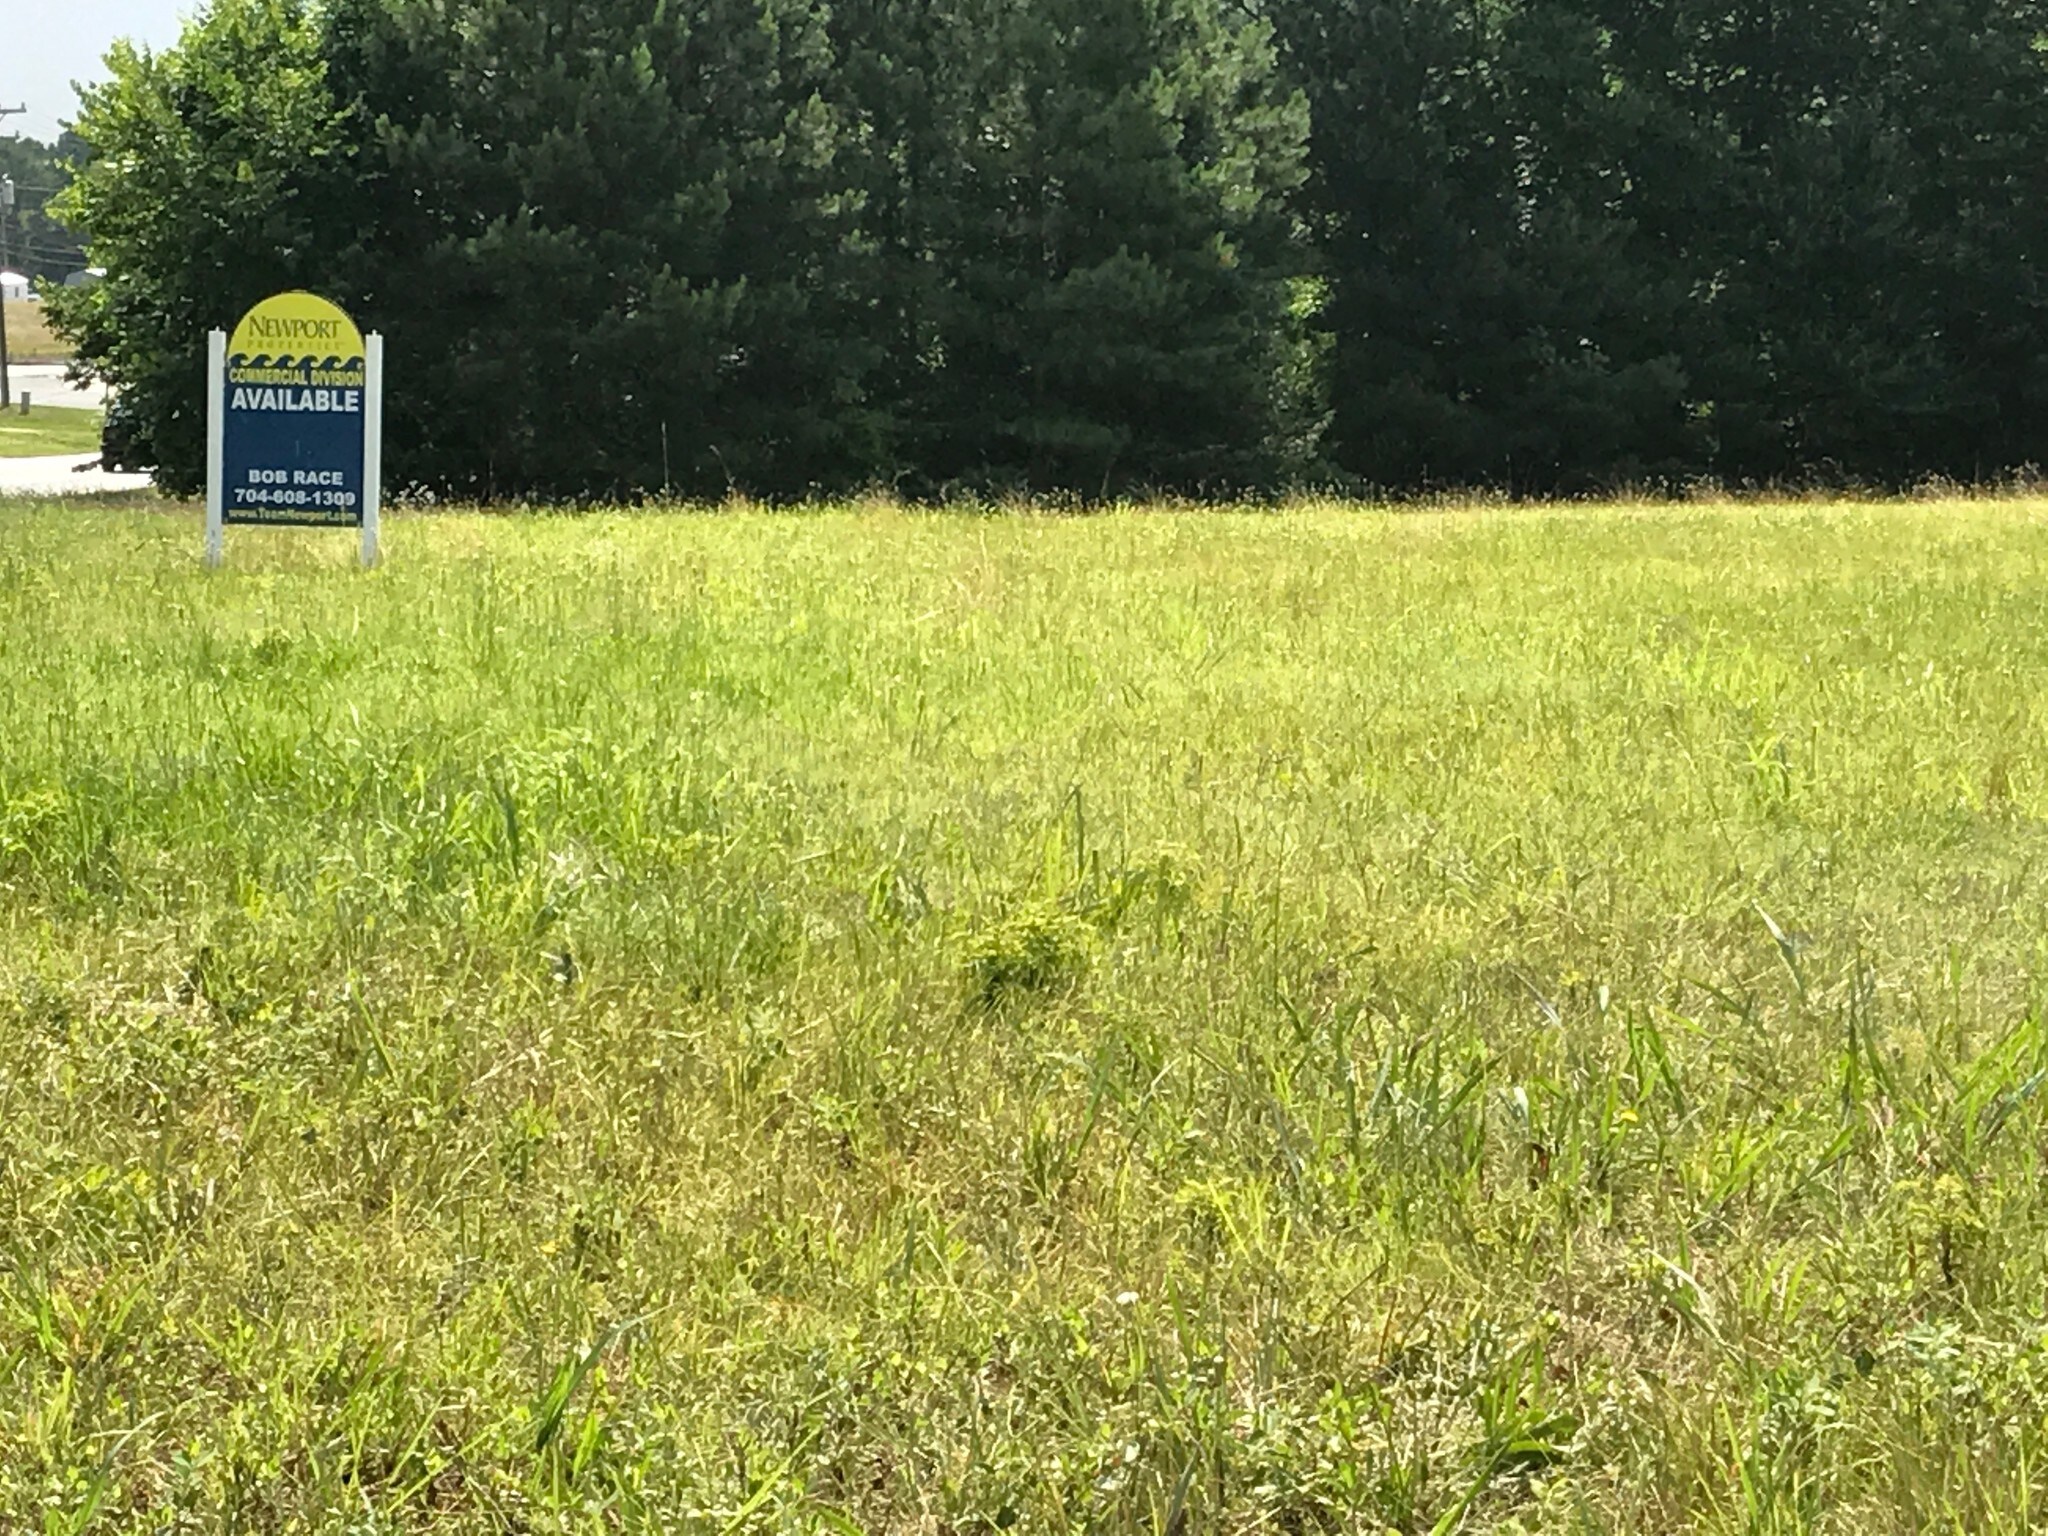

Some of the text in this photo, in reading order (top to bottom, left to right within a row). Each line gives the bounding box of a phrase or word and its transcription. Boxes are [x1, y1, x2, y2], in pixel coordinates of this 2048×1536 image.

[248, 316, 342, 339] NEWPORT
[229, 368, 364, 386] COMMERCIAL DIVISION
[231, 388, 359, 411] AVAILABLE
[248, 469, 344, 485] BOB RACE
[234, 488, 356, 506] 704-608-1309
